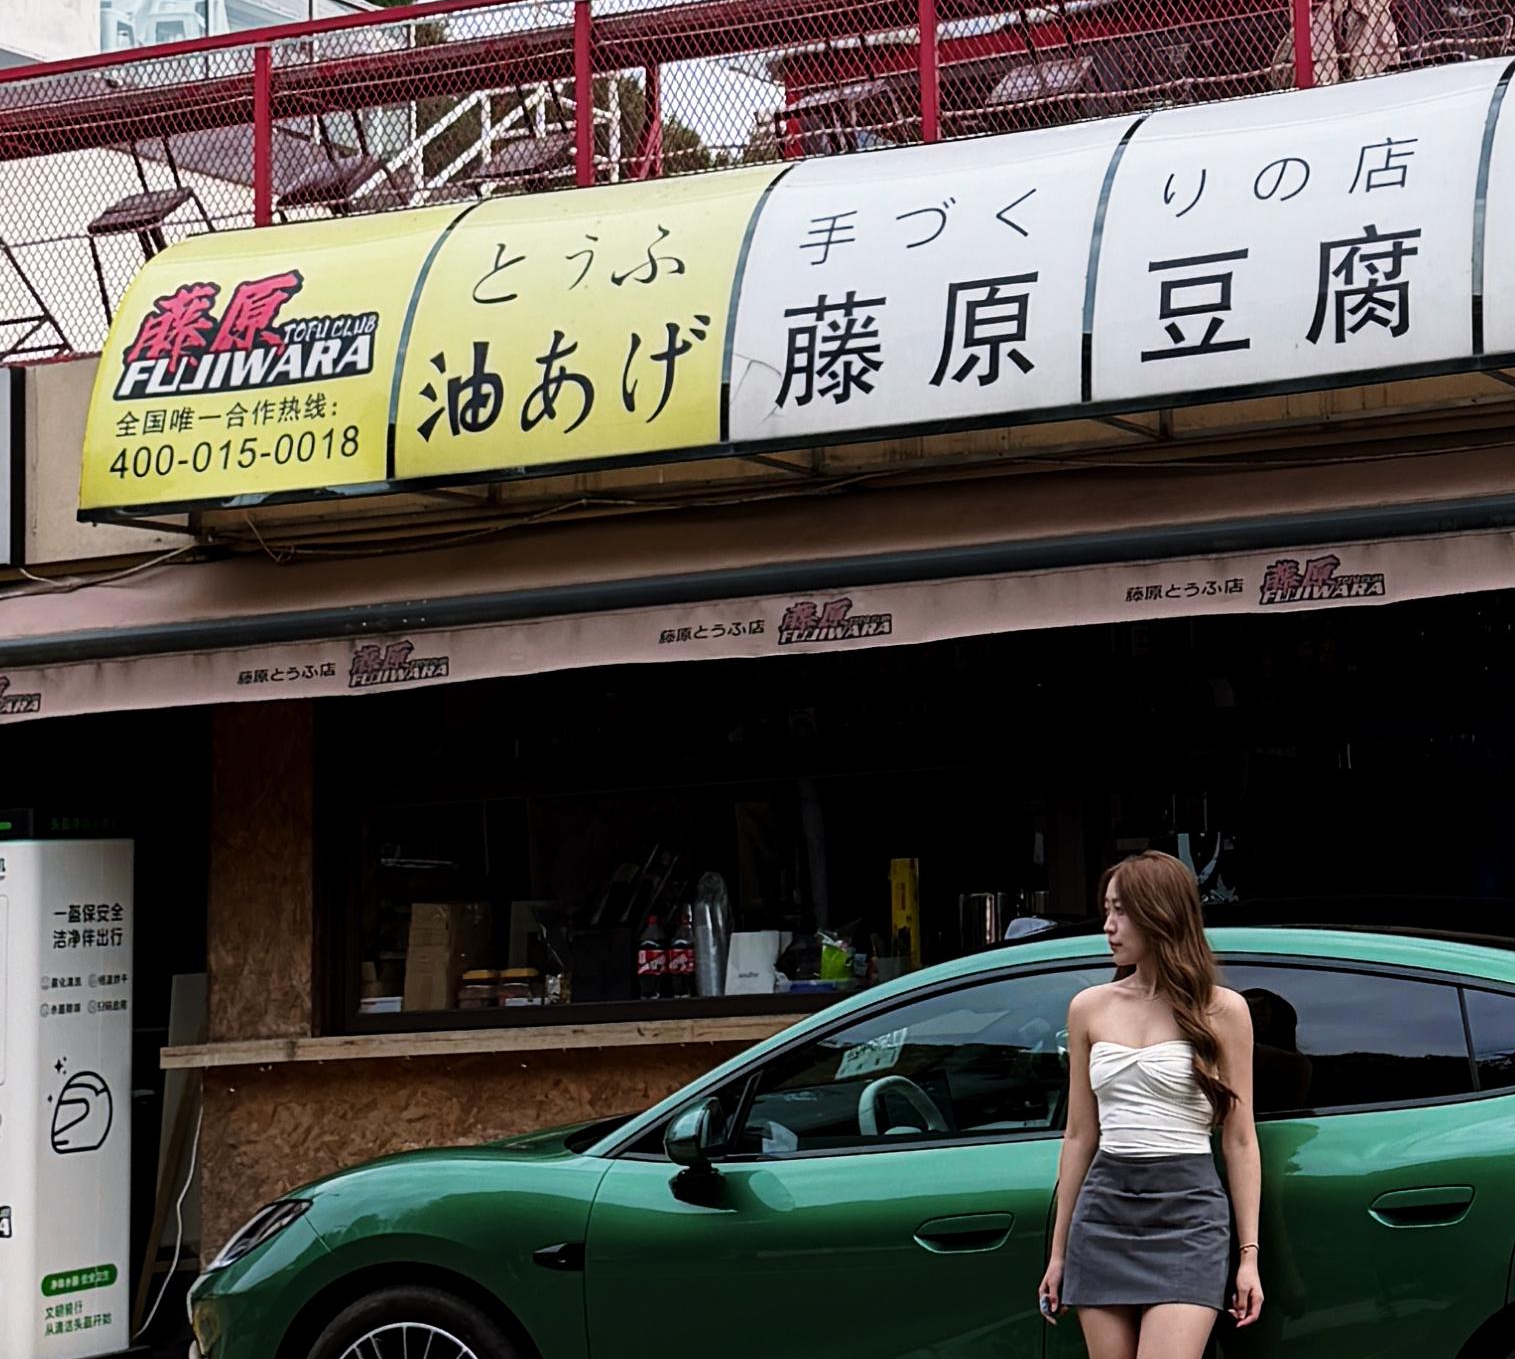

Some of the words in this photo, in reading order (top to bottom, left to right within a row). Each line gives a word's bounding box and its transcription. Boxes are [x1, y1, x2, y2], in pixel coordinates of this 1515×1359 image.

[472, 223, 686, 304] とうふ
[127, 272, 298, 373] 藤原
[284, 319, 328, 344] TOFU
[331, 315, 376, 338] CLUB
[118, 335, 372, 396] FUJIWARA
[417, 314, 711, 442] 油あげ
[109, 425, 359, 479] 400-015-0018
[1125, 578, 1244, 602] 藤原とうふ店
[1261, 581, 1385, 604] FUJIWARA
[659, 619, 765, 644] 藤原とうふ店
[780, 621, 891, 644] FUJIWARA
[237, 662, 336, 685] 藤原とうふ店
[350, 664, 449, 687] FUJIWARA
